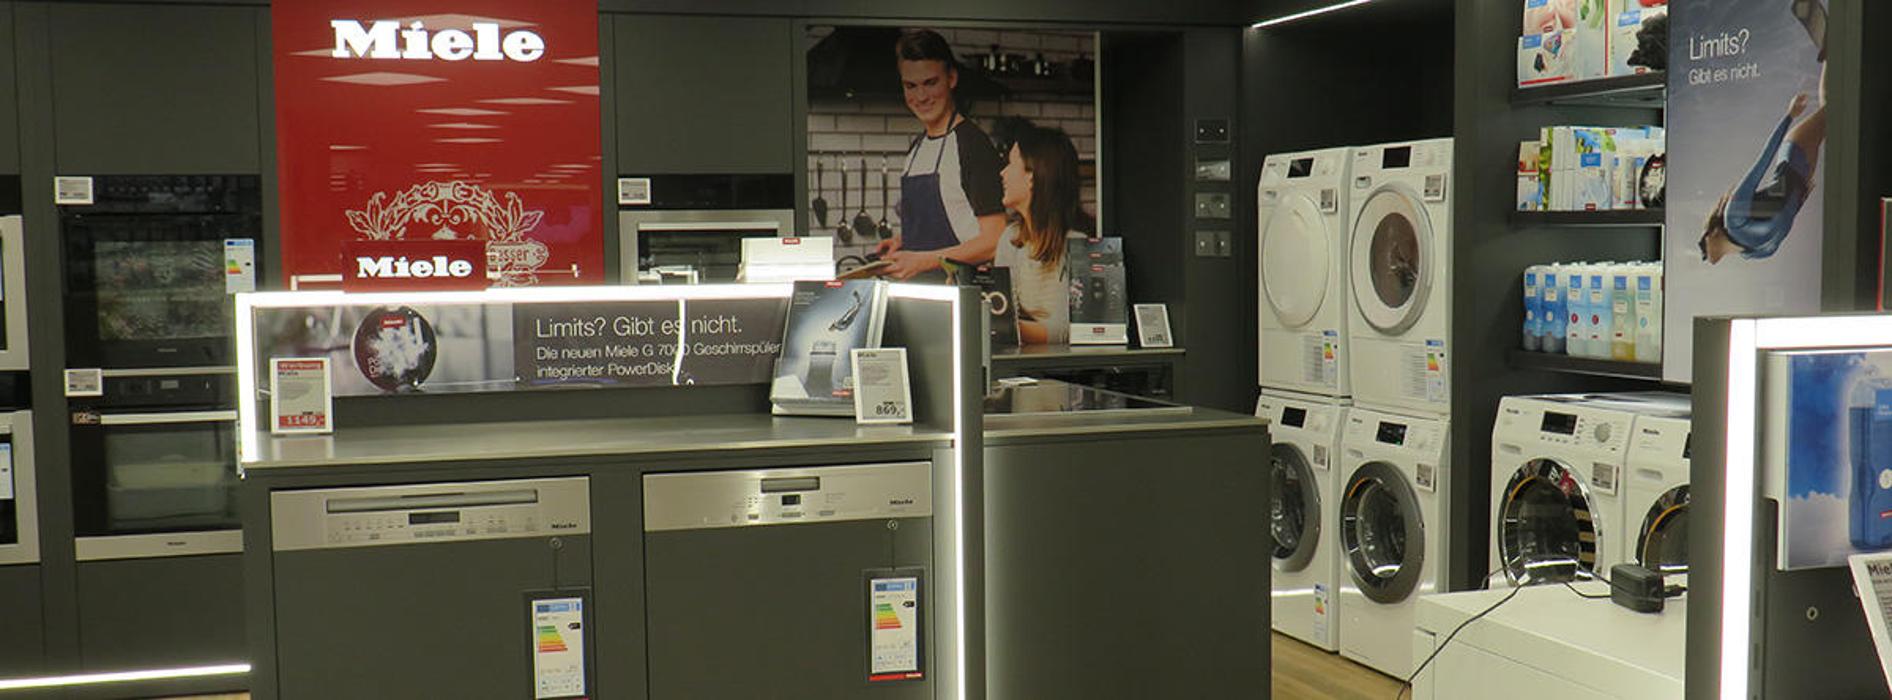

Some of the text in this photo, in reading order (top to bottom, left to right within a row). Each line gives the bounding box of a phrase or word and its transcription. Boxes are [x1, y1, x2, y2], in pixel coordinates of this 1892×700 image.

[330, 20, 545, 62] Miele
[1689, 28, 1750, 60] Limits?
[1688, 68, 1712, 85] Gibt
[1713, 68, 1729, 82] es
[356, 256, 473, 279] Miele
[536, 314, 743, 338] Limits? Gibt es nicht.
[536, 346, 558, 360] Die
[562, 346, 601, 359] neuen
[605, 345, 639, 358] Miele
[642, 344, 655, 357] G
[693, 341, 782, 356] Geschirrspüler
[536, 363, 604, 380] integrierter
[1867, 562, 1892, 577] Mie
